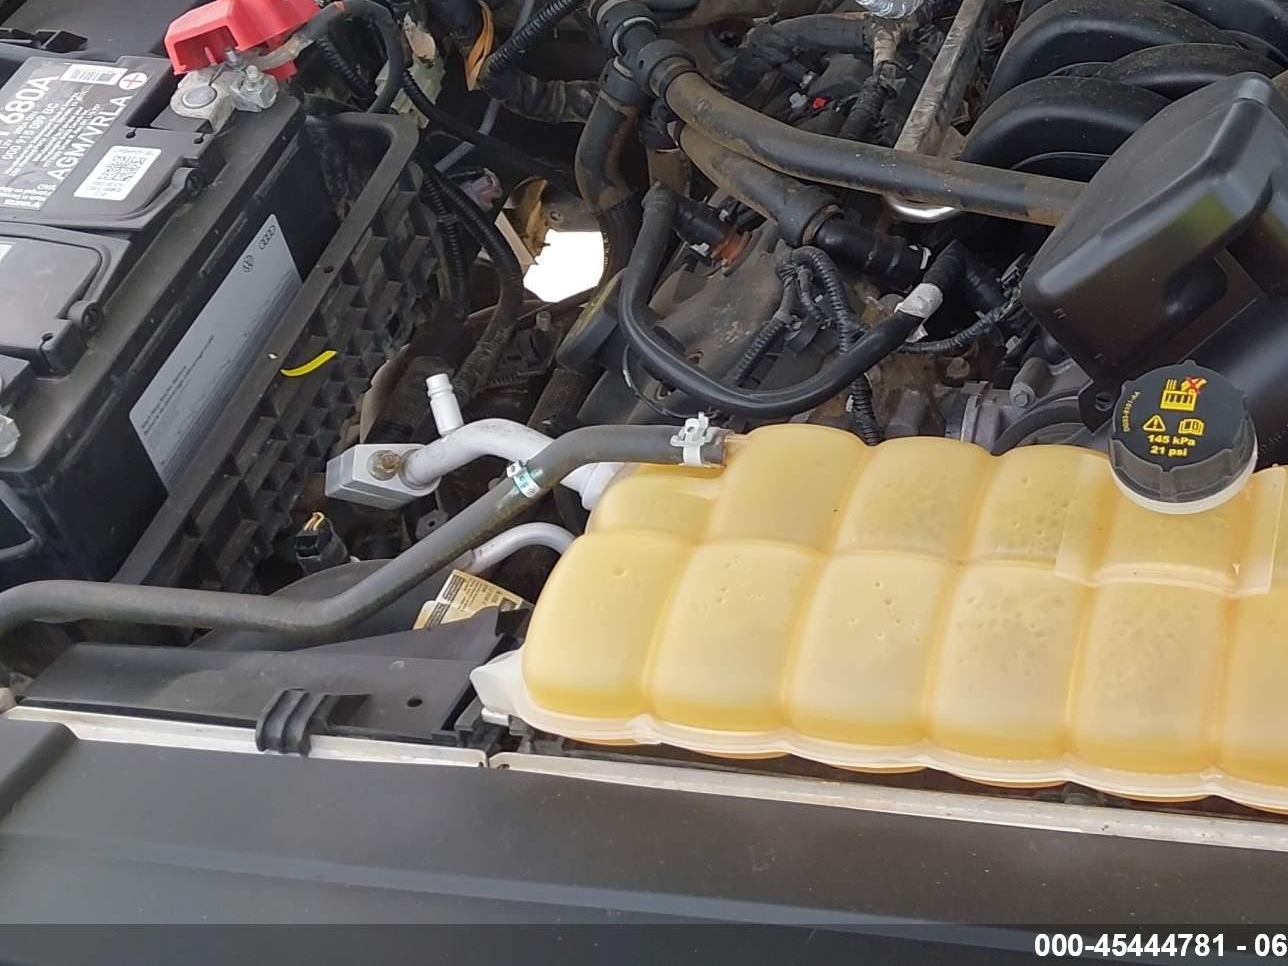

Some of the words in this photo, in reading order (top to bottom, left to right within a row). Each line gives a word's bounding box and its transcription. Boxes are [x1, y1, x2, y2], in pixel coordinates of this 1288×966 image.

[0, 76, 60, 124] 680A
[48, 95, 133, 181] AGM/VRLA
[1147, 434, 1170, 445] 145
[1172, 434, 1197, 446] kPa
[1150, 445, 1166, 455] 21
[1168, 446, 1188, 457] psi
